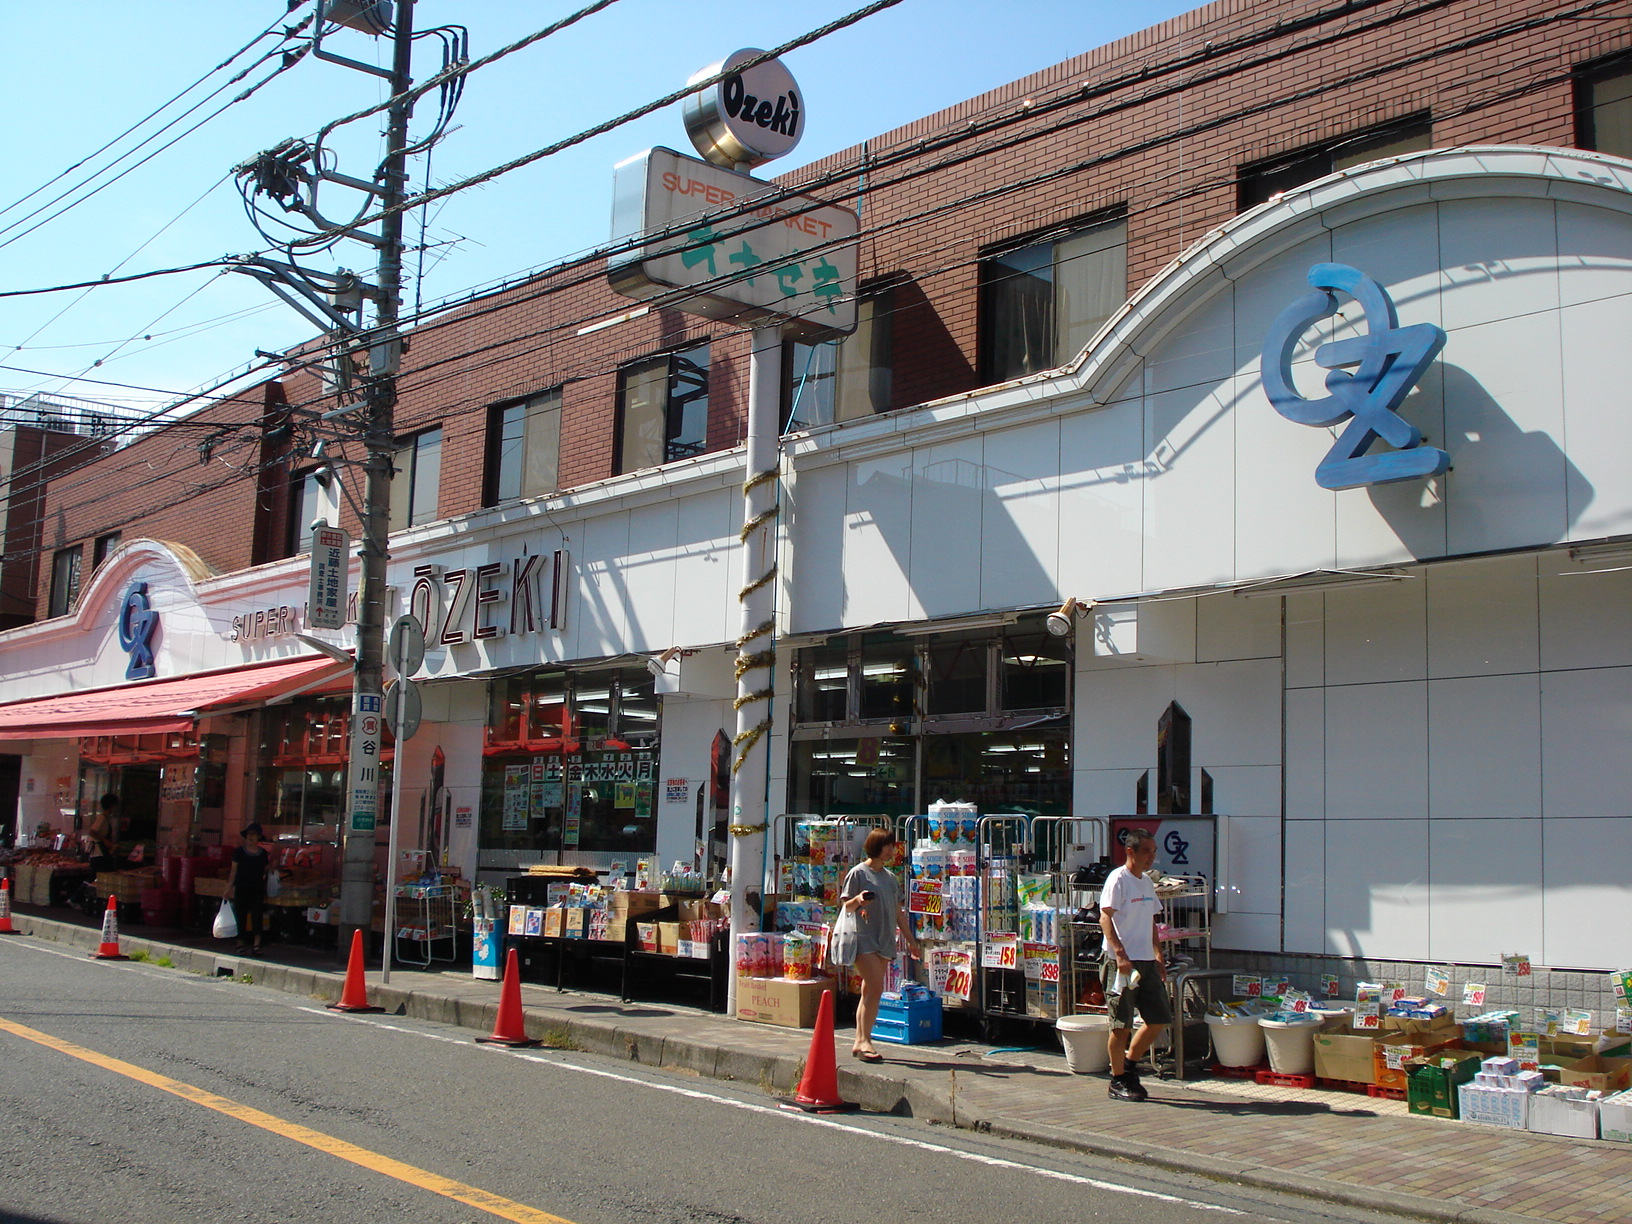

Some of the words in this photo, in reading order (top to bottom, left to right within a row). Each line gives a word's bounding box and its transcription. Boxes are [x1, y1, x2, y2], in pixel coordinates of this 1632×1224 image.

[662, 172, 736, 207] SUPER
[231, 605, 294, 643] SUPER
[361, 740, 376, 783] 谷川
[547, 764, 561, 779] 土
[568, 765, 582, 780] 金
[585, 764, 599, 780] 木
[601, 763, 616, 779] 水
[618, 762, 634, 779] 火
[638, 761, 651, 778] 月
[926, 895, 941, 913] 328
[1000, 946, 1015, 966] 158
[1041, 963, 1059, 980] 398
[945, 968, 971, 997] 208
[752, 995, 780, 1008] PEACH
